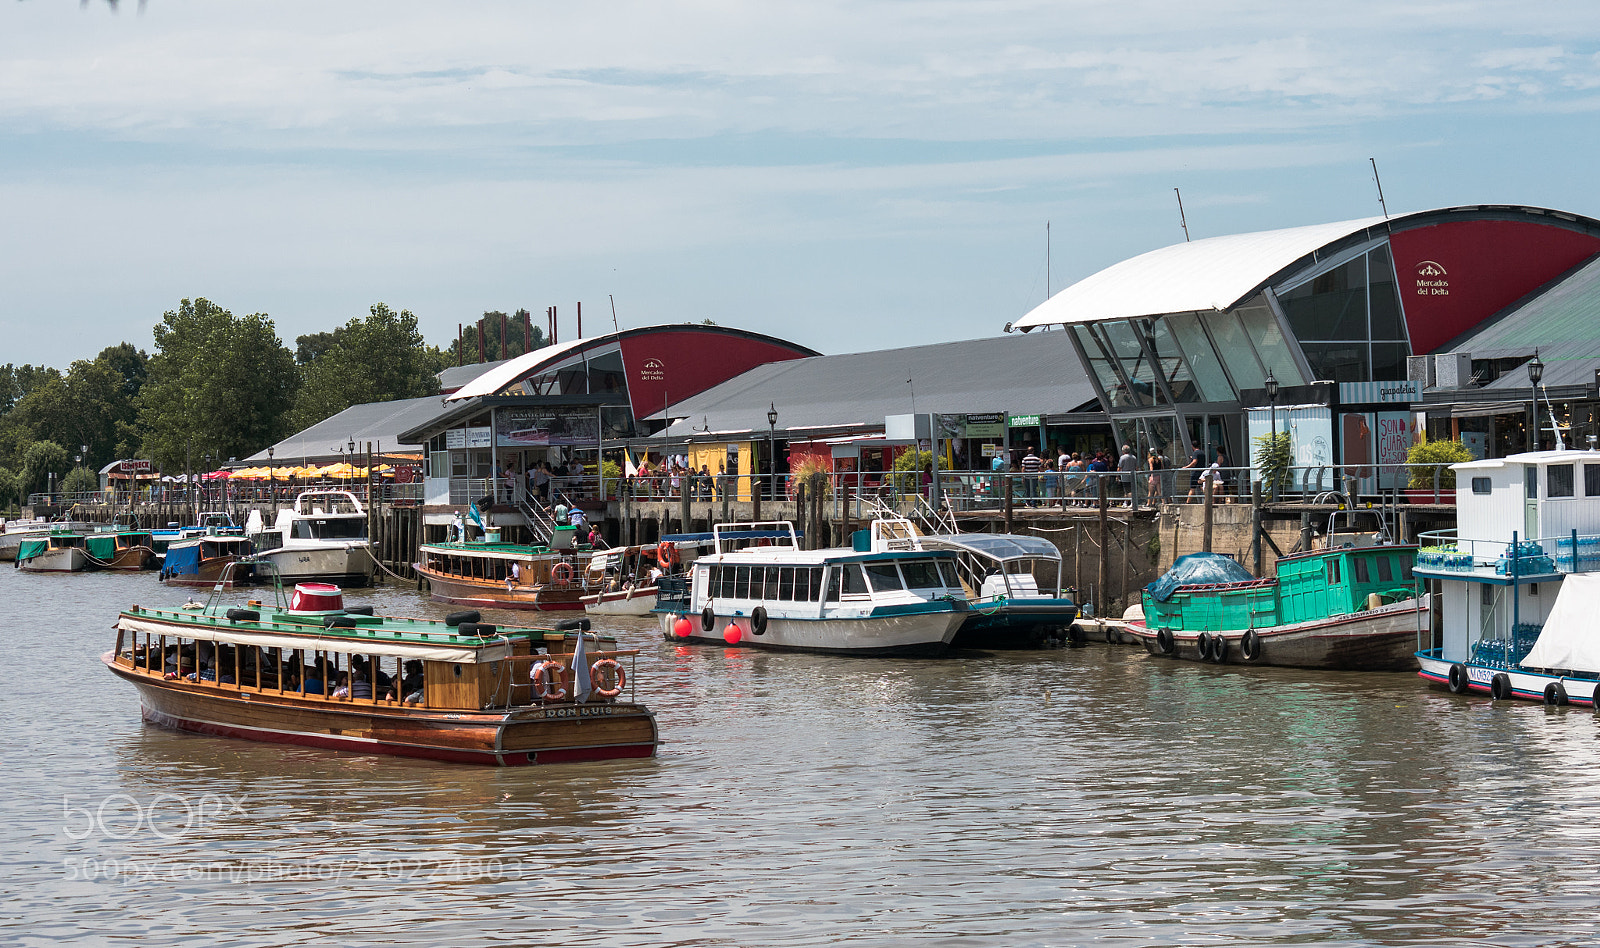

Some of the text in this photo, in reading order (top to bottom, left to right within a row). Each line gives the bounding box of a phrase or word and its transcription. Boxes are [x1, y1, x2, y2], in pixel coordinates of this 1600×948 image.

[1416, 279, 1449, 287] Mercados
[1381, 384, 1416, 401] guapaletas
[1011, 415, 1039, 426] natventure
[1380, 419, 1398, 437] SON
[545, 706, 612, 718] DON LUIS
